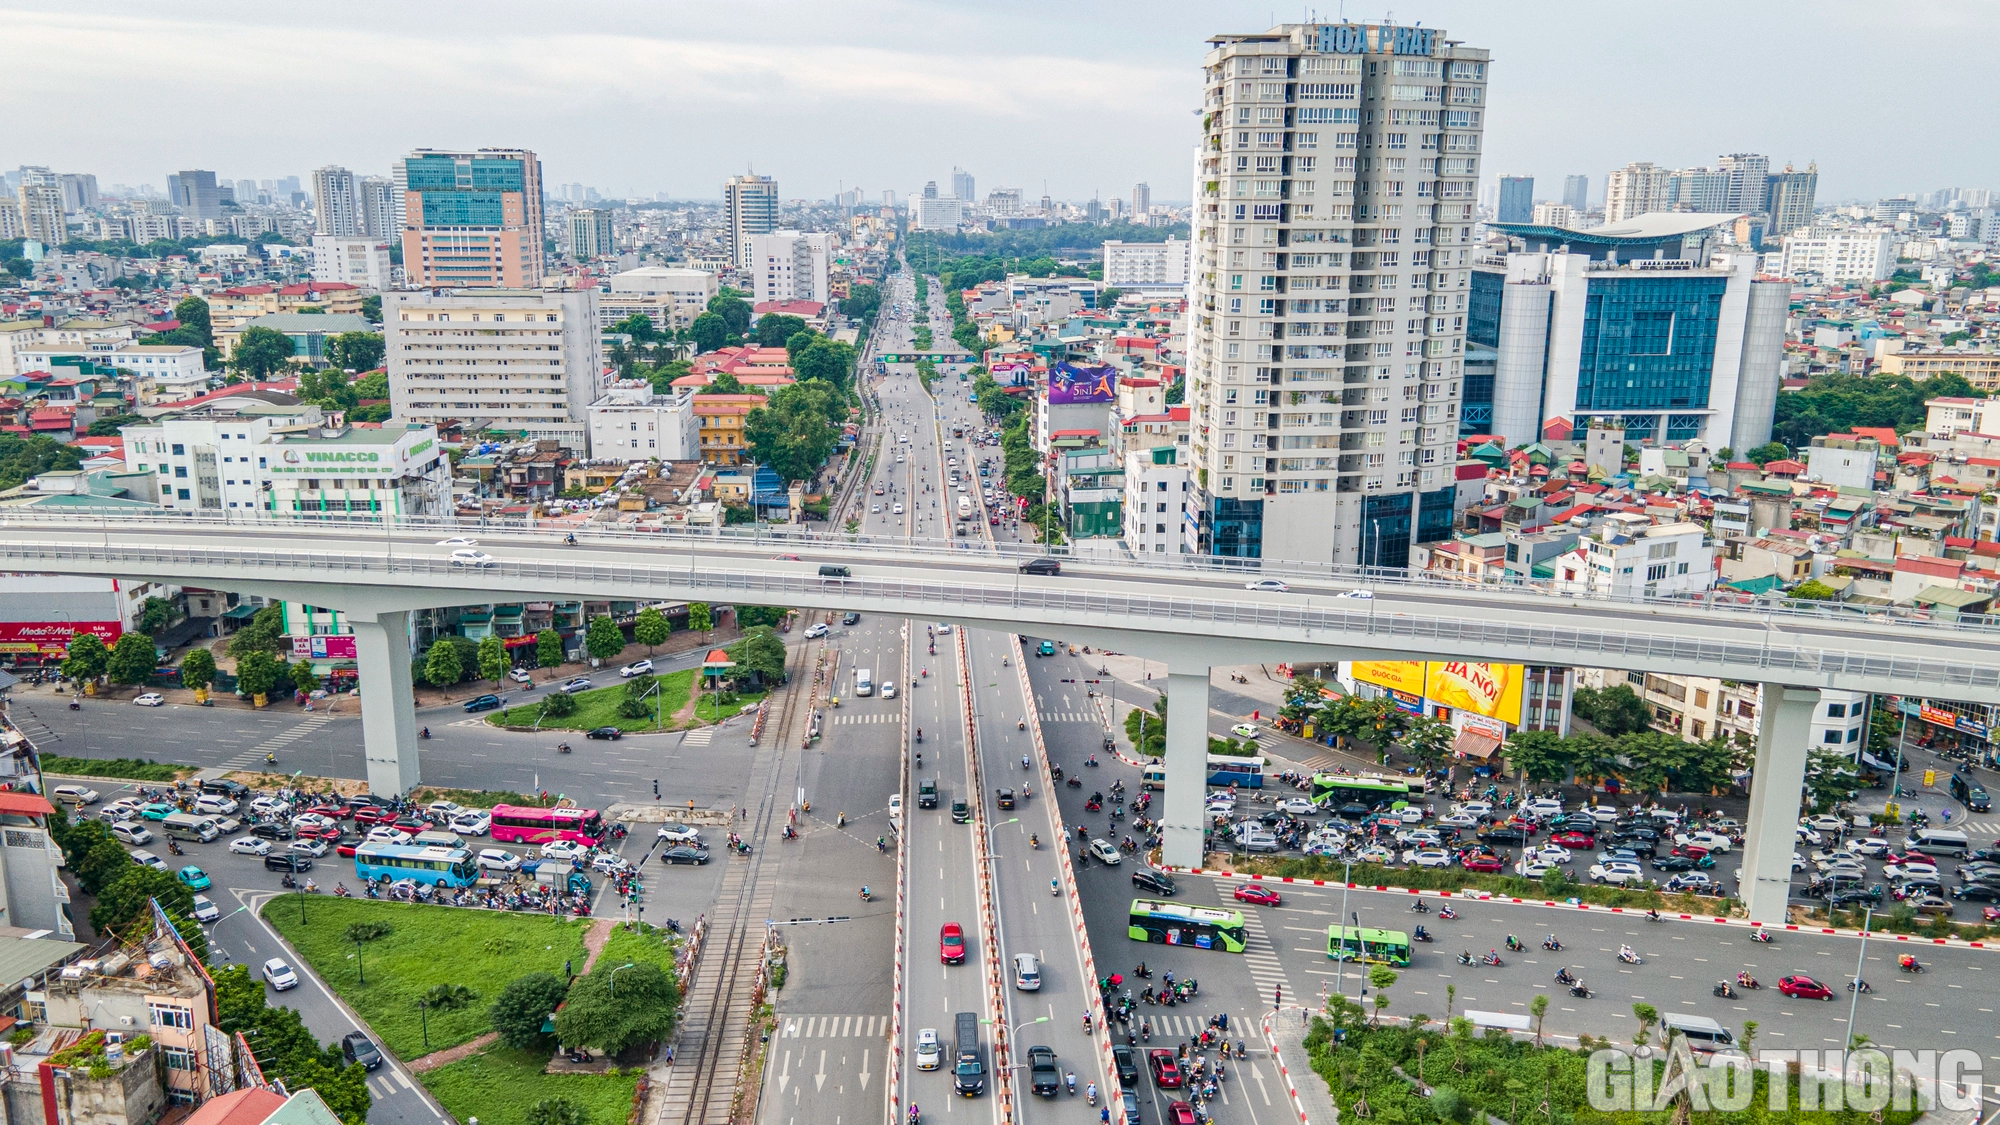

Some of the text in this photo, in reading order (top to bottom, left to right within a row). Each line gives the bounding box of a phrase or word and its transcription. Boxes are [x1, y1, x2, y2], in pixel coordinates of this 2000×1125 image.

[305, 452, 379, 462] VINACCO
[409, 438, 433, 457] VINACCO
[1444, 662, 1468, 679] HÀ
[1470, 670, 1499, 702] NỘI
